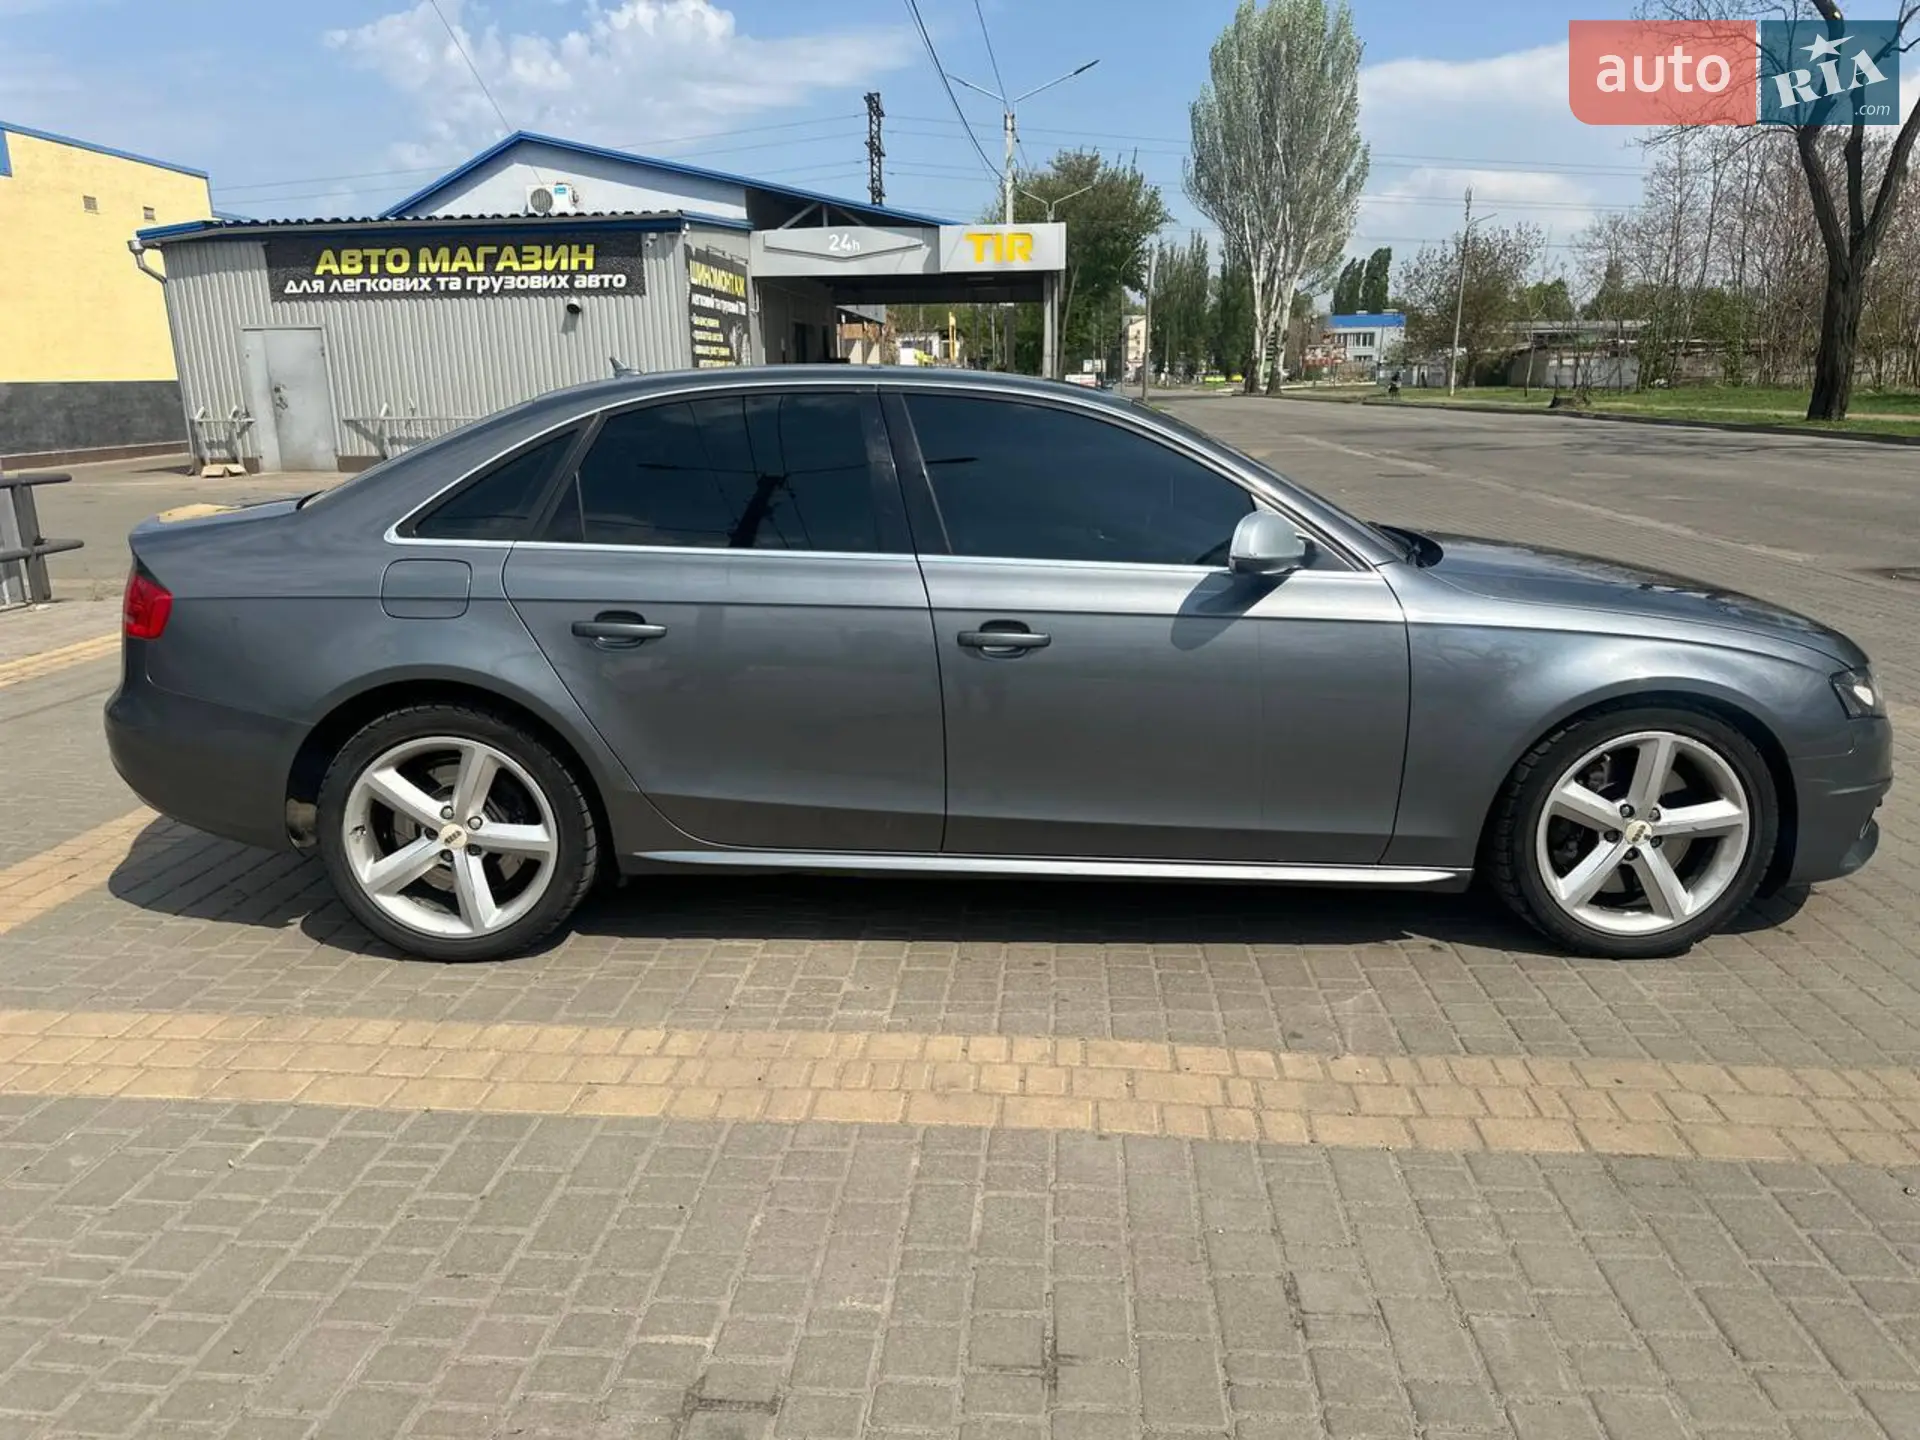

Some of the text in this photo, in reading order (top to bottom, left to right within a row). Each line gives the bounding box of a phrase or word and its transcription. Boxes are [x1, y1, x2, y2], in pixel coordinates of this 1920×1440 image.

[828, 234, 860, 251] 24h
[964, 232, 1034, 263] TIR
[314, 243, 595, 276] АВТО МАГАЗИН
[328, 276, 432, 293] легкових
[436, 275, 460, 291] та
[465, 274, 569, 295] грузових
[574, 273, 627, 289] авто
